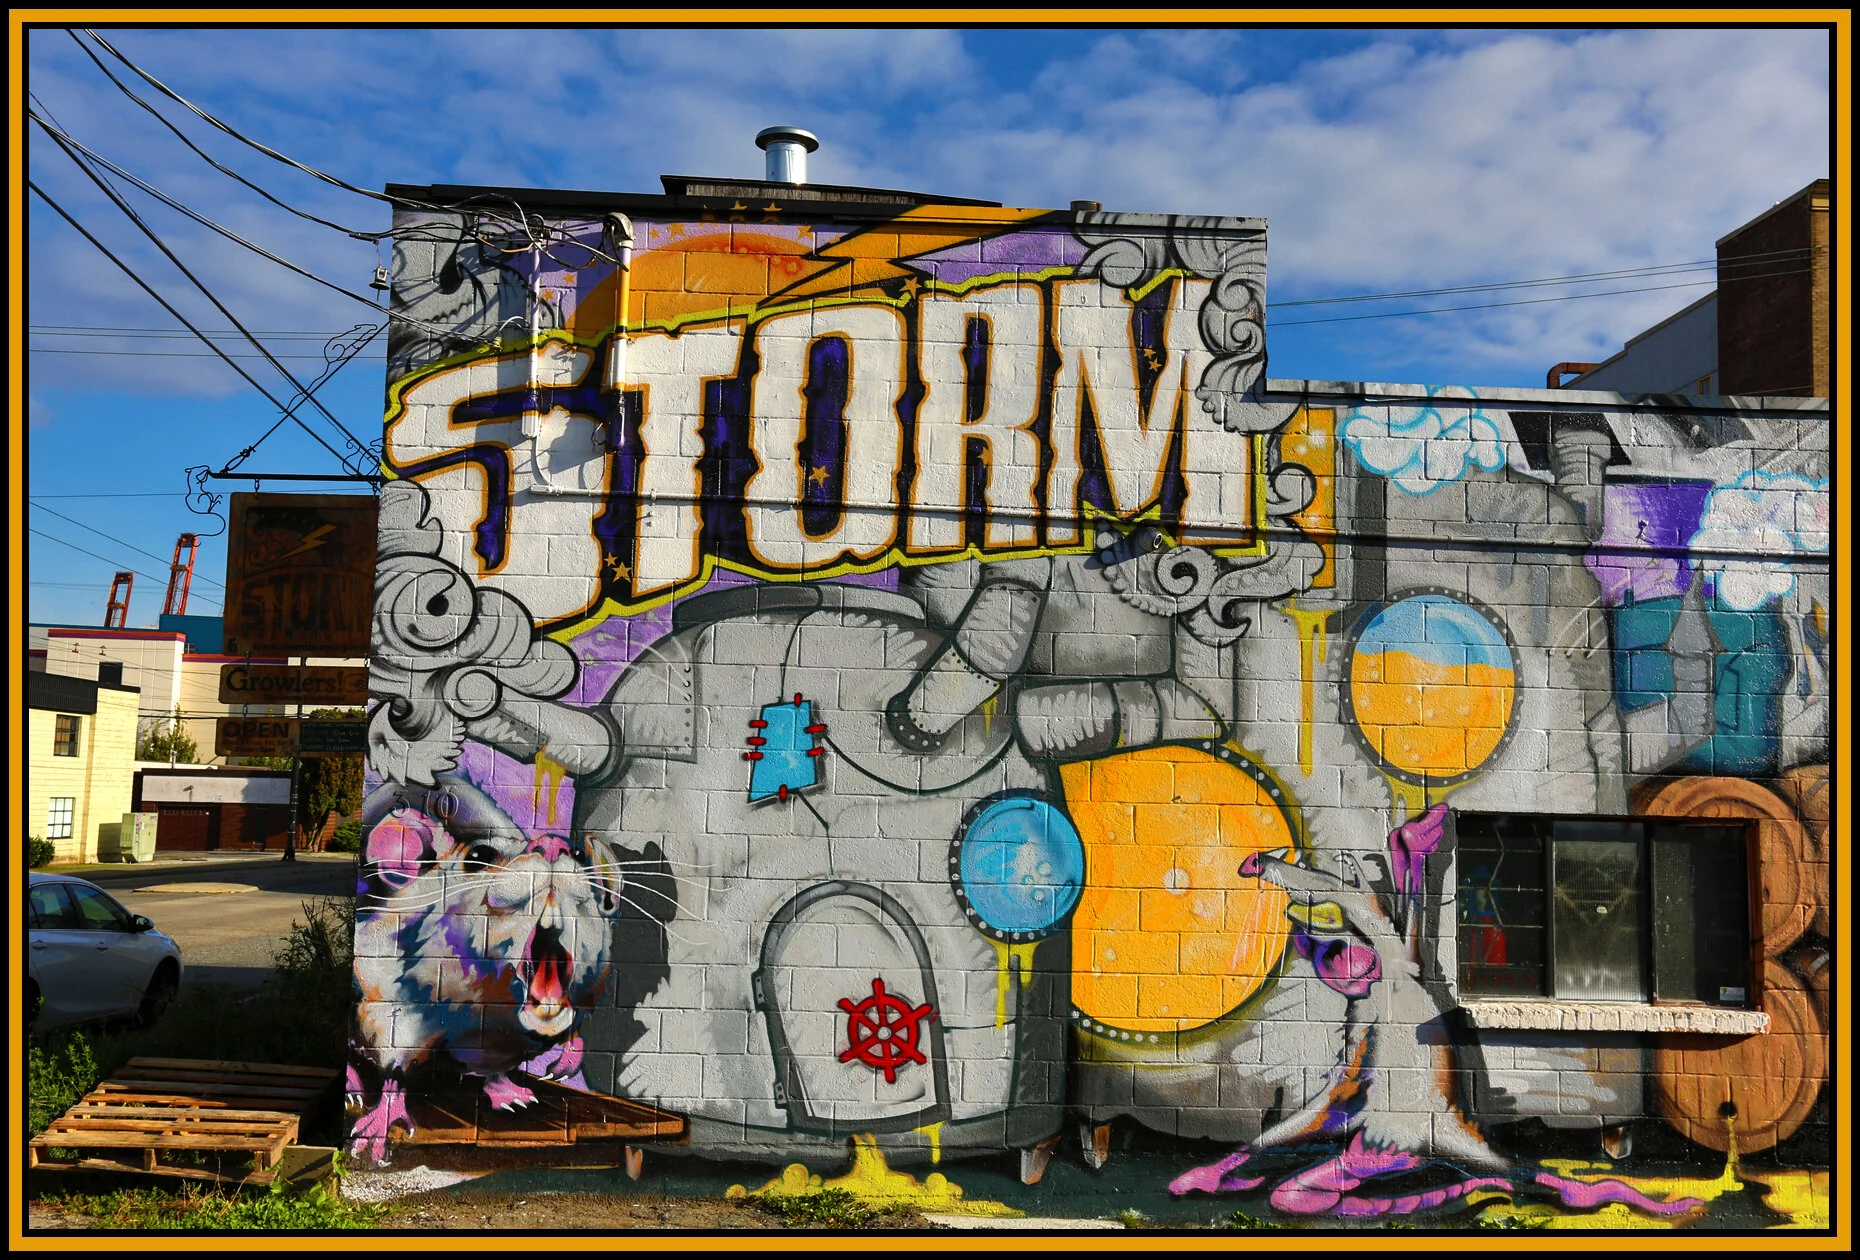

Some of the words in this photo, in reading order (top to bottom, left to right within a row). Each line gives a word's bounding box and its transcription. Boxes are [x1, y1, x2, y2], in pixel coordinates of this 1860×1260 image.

[386, 275, 1254, 628] STORM
[226, 667, 344, 692] Growlers!
[223, 721, 290, 738] OPEN
